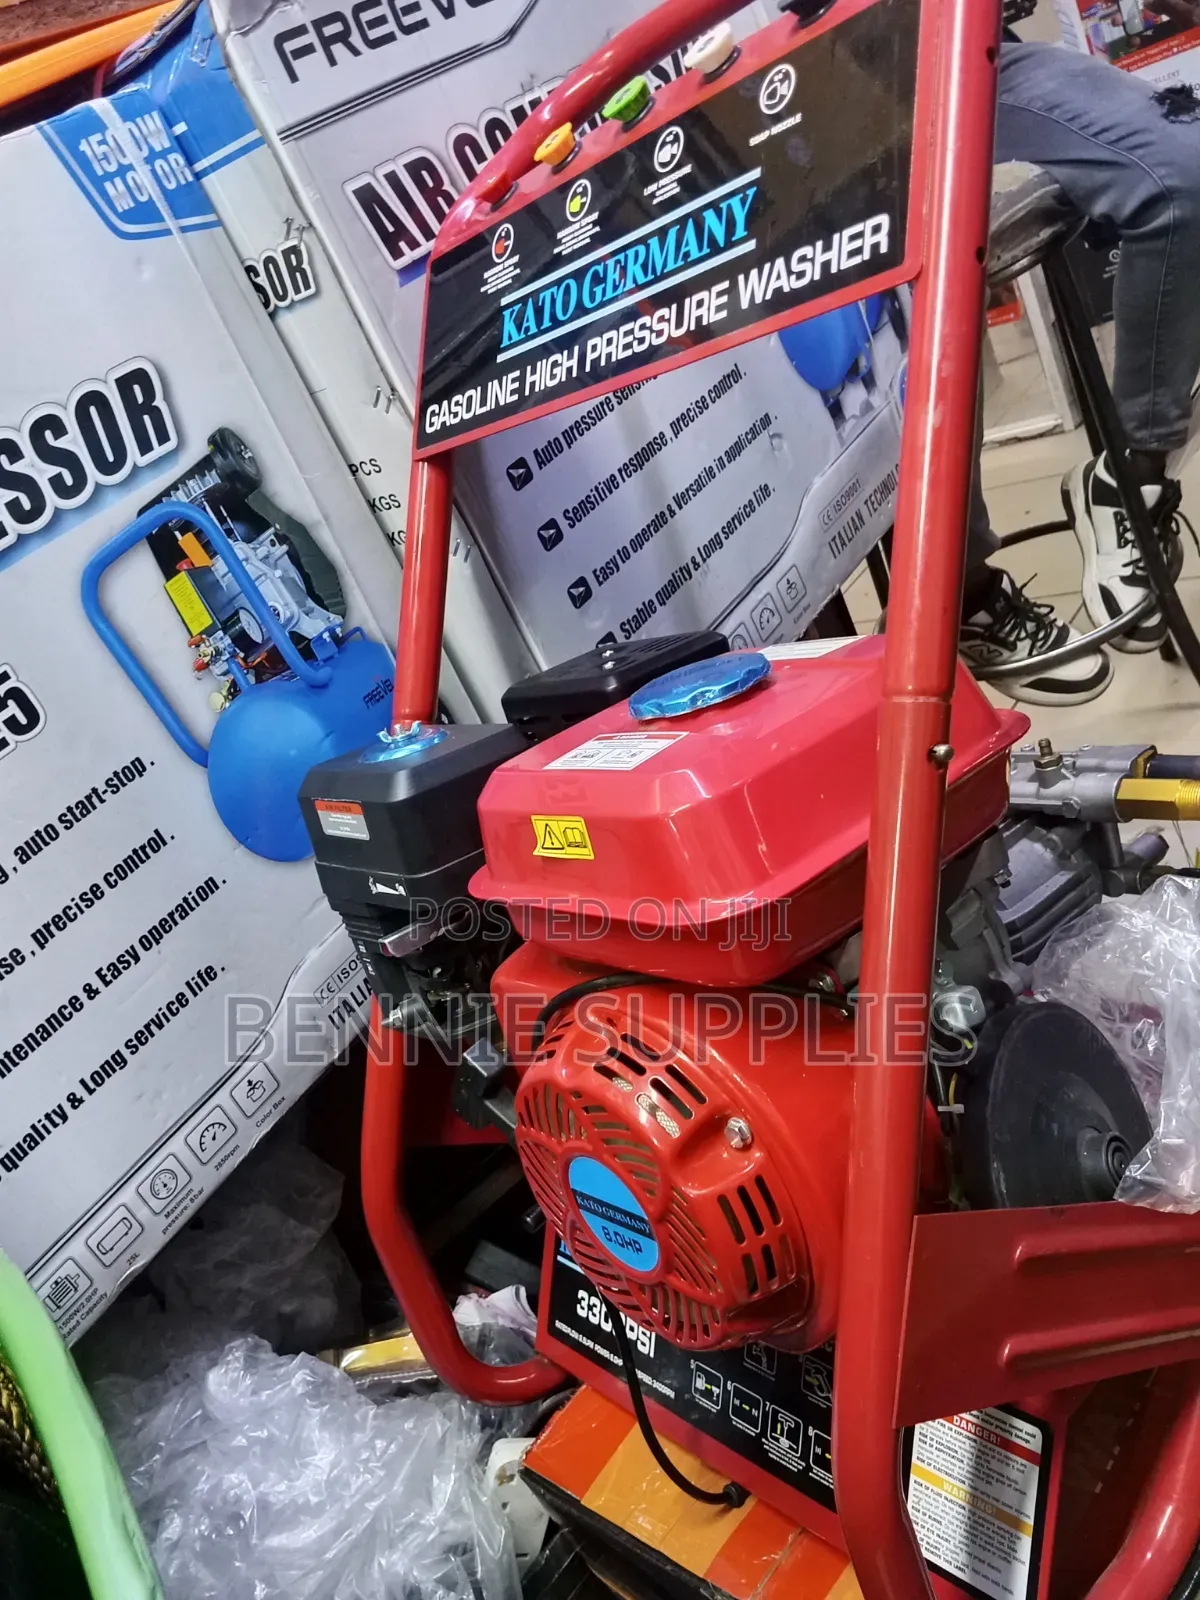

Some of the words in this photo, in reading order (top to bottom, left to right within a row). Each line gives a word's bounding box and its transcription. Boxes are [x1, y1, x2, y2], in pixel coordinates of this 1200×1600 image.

[274, 0, 496, 84] FREE
[104, 152, 194, 213] MOOR
[350, 154, 461, 262] AIR
[499, 278, 577, 348] KATO
[581, 187, 757, 310] GERMANY
[424, 375, 519, 434] GASOLINE
[523, 347, 579, 394] HIGH
[584, 280, 730, 373] PRESSURE
[737, 214, 890, 309] WASHER
[532, 434, 564, 470] Auto
[560, 394, 615, 451] pressure
[350, 458, 382, 478] PCS
[562, 473, 620, 530] Sensitive
[669, 394, 710, 439] precise
[367, 493, 401, 514] KGS
[592, 554, 621, 587] Easy
[617, 543, 631, 565] to
[629, 508, 668, 554] operate
[667, 502, 677, 519] &
[672, 465, 717, 510] Versatile
[714, 458, 725, 477] in
[828, 508, 866, 559] ITALIAN
[618, 597, 658, 641] Stable
[655, 559, 694, 608] quality
[690, 552, 702, 570] &
[699, 533, 725, 565] Long
[720, 500, 757, 543] service
[13, 823, 60, 865] auto
[30, 883, 105, 950] precise
[82, 982, 102, 1001] &
[95, 945, 141, 989] Easy
[0, 1103, 69, 1173] quality
[66, 1091, 86, 1110] &
[78, 1049, 128, 1096] Long
[124, 991, 190, 1056] service
[255, 1109, 273, 1129] Color
[272, 1096, 287, 1111] Box
[214, 1144, 240, 1172] 2850rpm
[164, 1187, 195, 1220] Maximum
[576, 1195, 602, 1212] KATO
[602, 1208, 652, 1233] GERMANY
[126, 1252, 141, 1267] 25L
[601, 1225, 644, 1255] 8.0HP
[58, 1288, 100, 1331] 1500W/2.0HP
[80, 1291, 109, 1323] Capacity
[576, 1289, 656, 1358] 330PSI
[953, 1415, 1001, 1446] DANGER!
[942, 1481, 997, 1517] WARNING!
